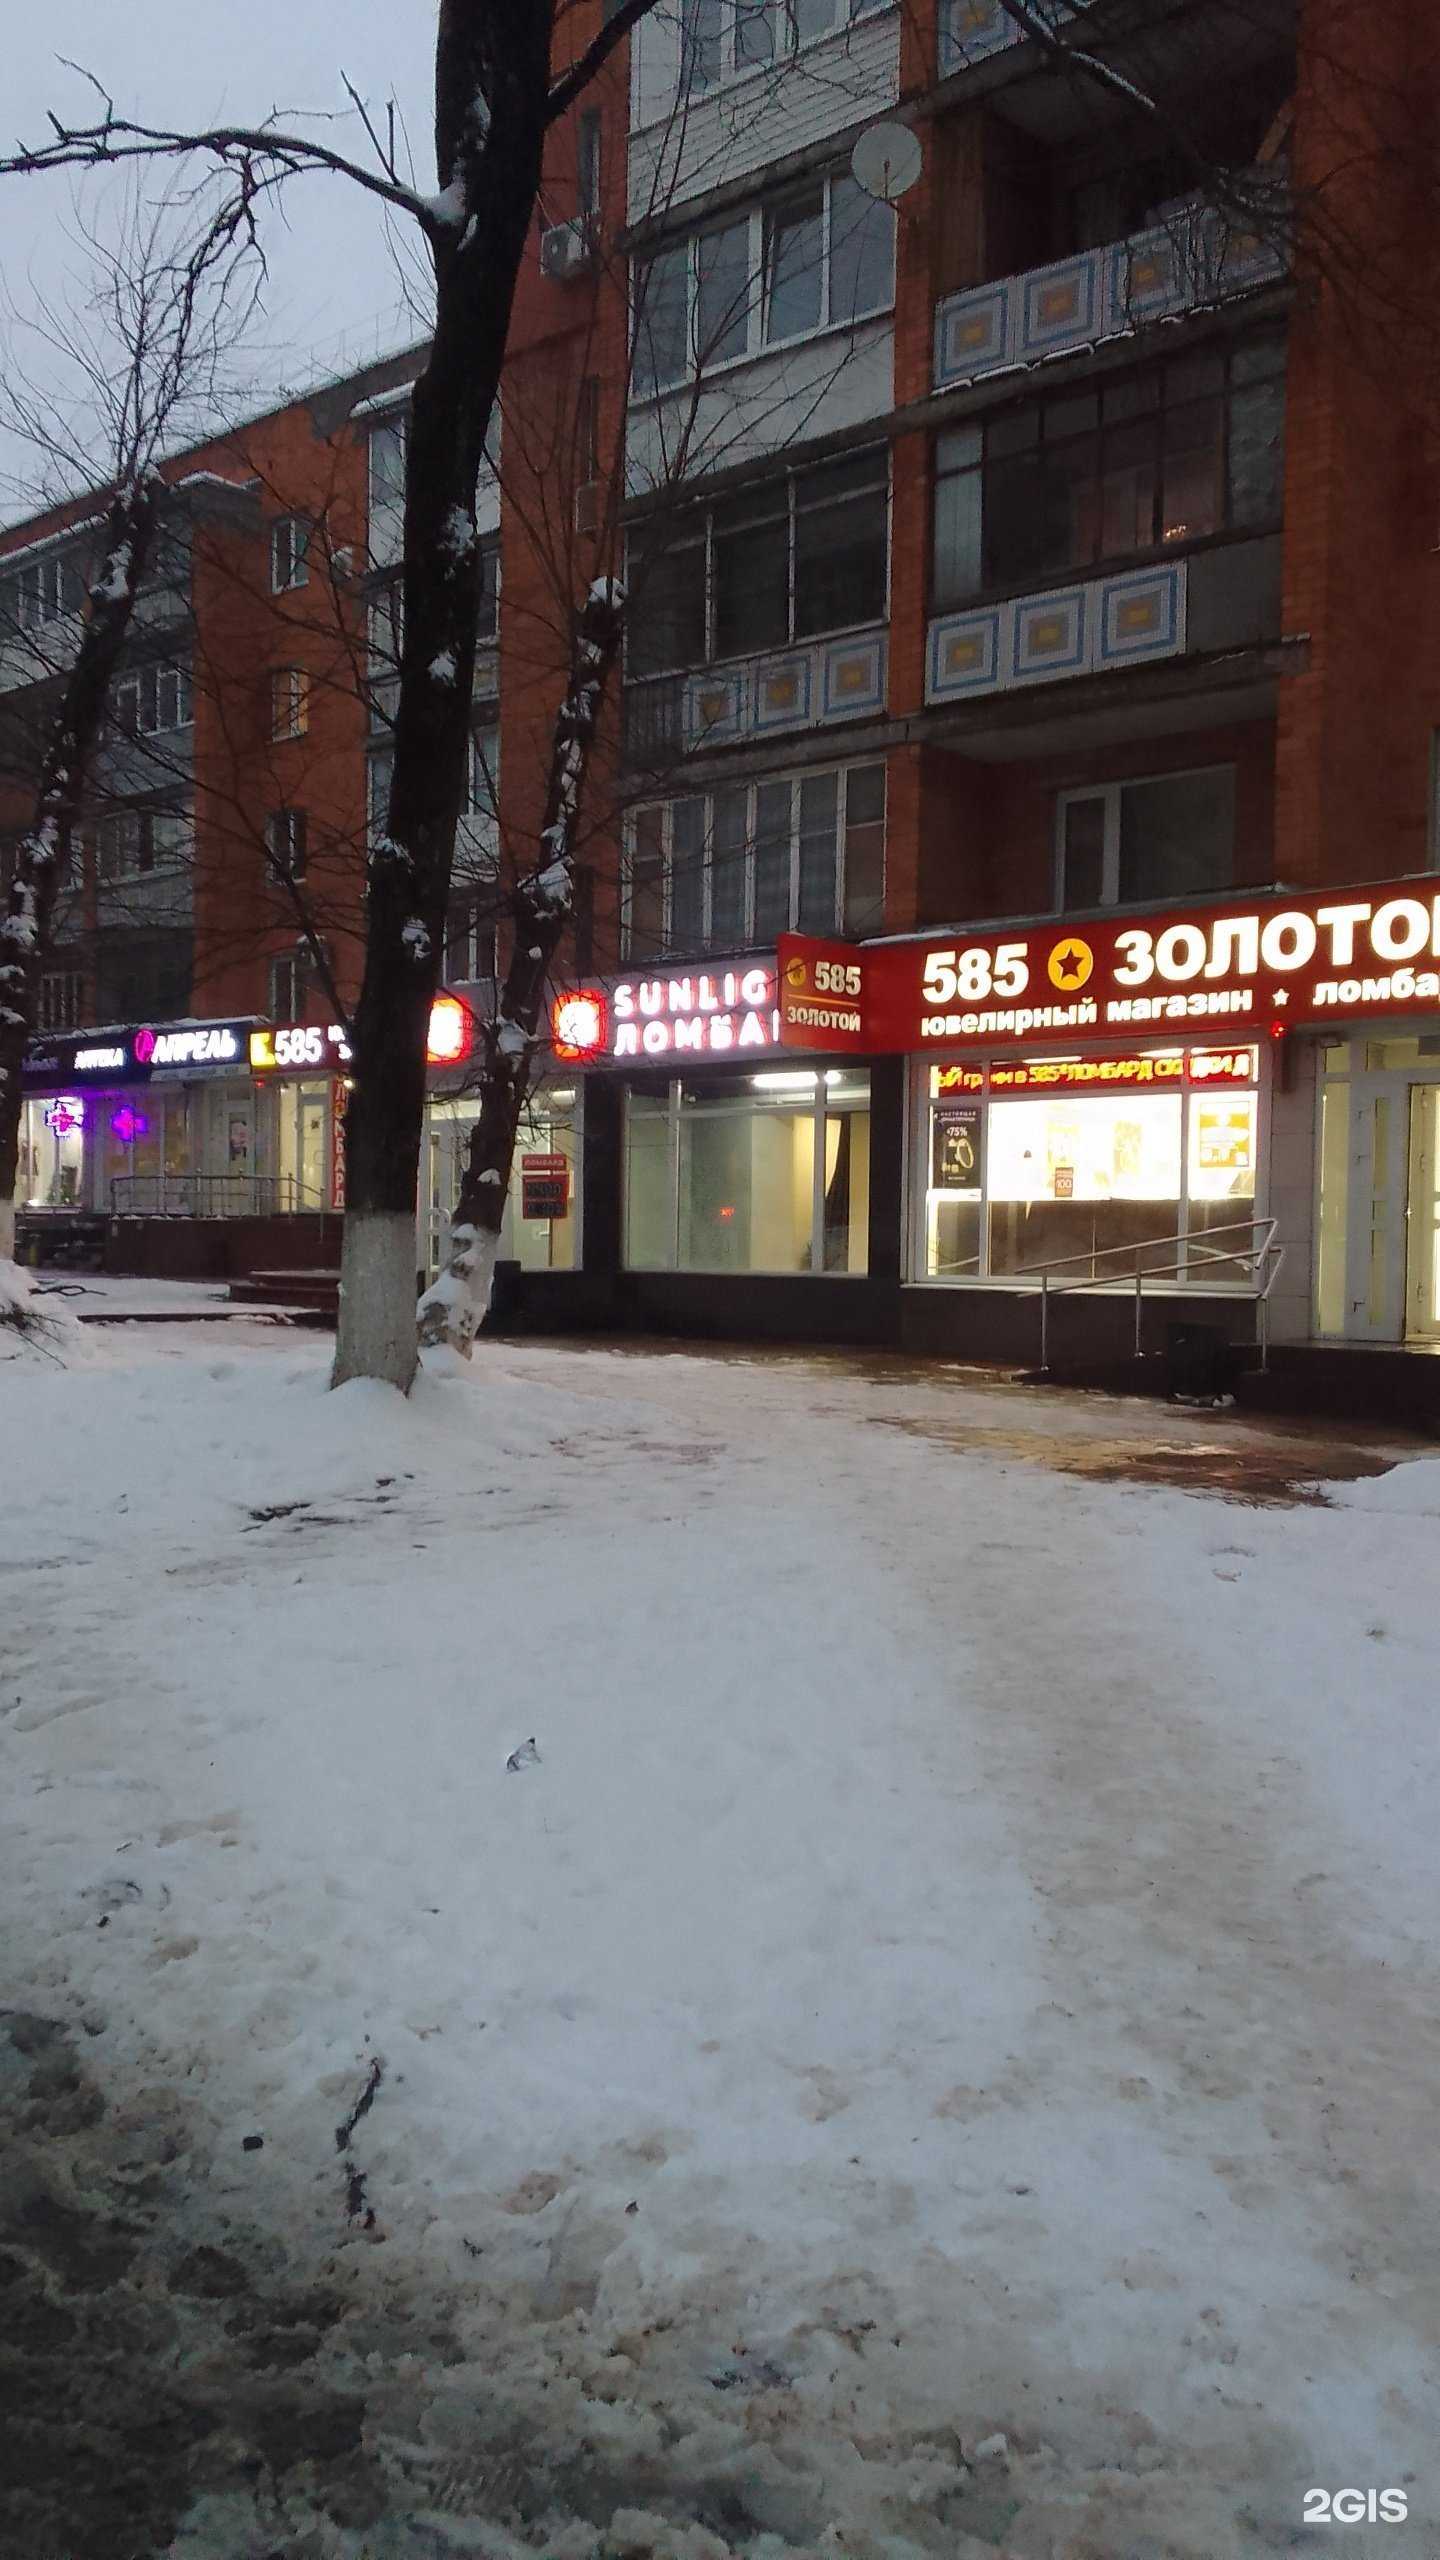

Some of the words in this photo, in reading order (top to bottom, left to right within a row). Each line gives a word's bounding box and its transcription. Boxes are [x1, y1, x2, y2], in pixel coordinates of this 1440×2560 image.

[922, 942, 1029, 1003] 585
[1113, 894, 1440, 985] ЗОЛОТО
[614, 969, 768, 1017] SUNLIG
[815, 961, 861, 995] 585
[787, 1005, 861, 1032] ЗОЛОТОЙ
[921, 997, 1098, 1037] ювелирный
[1106, 989, 1253, 1023] магазин
[1312, 967, 1440, 1006] ломба
[274, 1026, 321, 1065] 585
